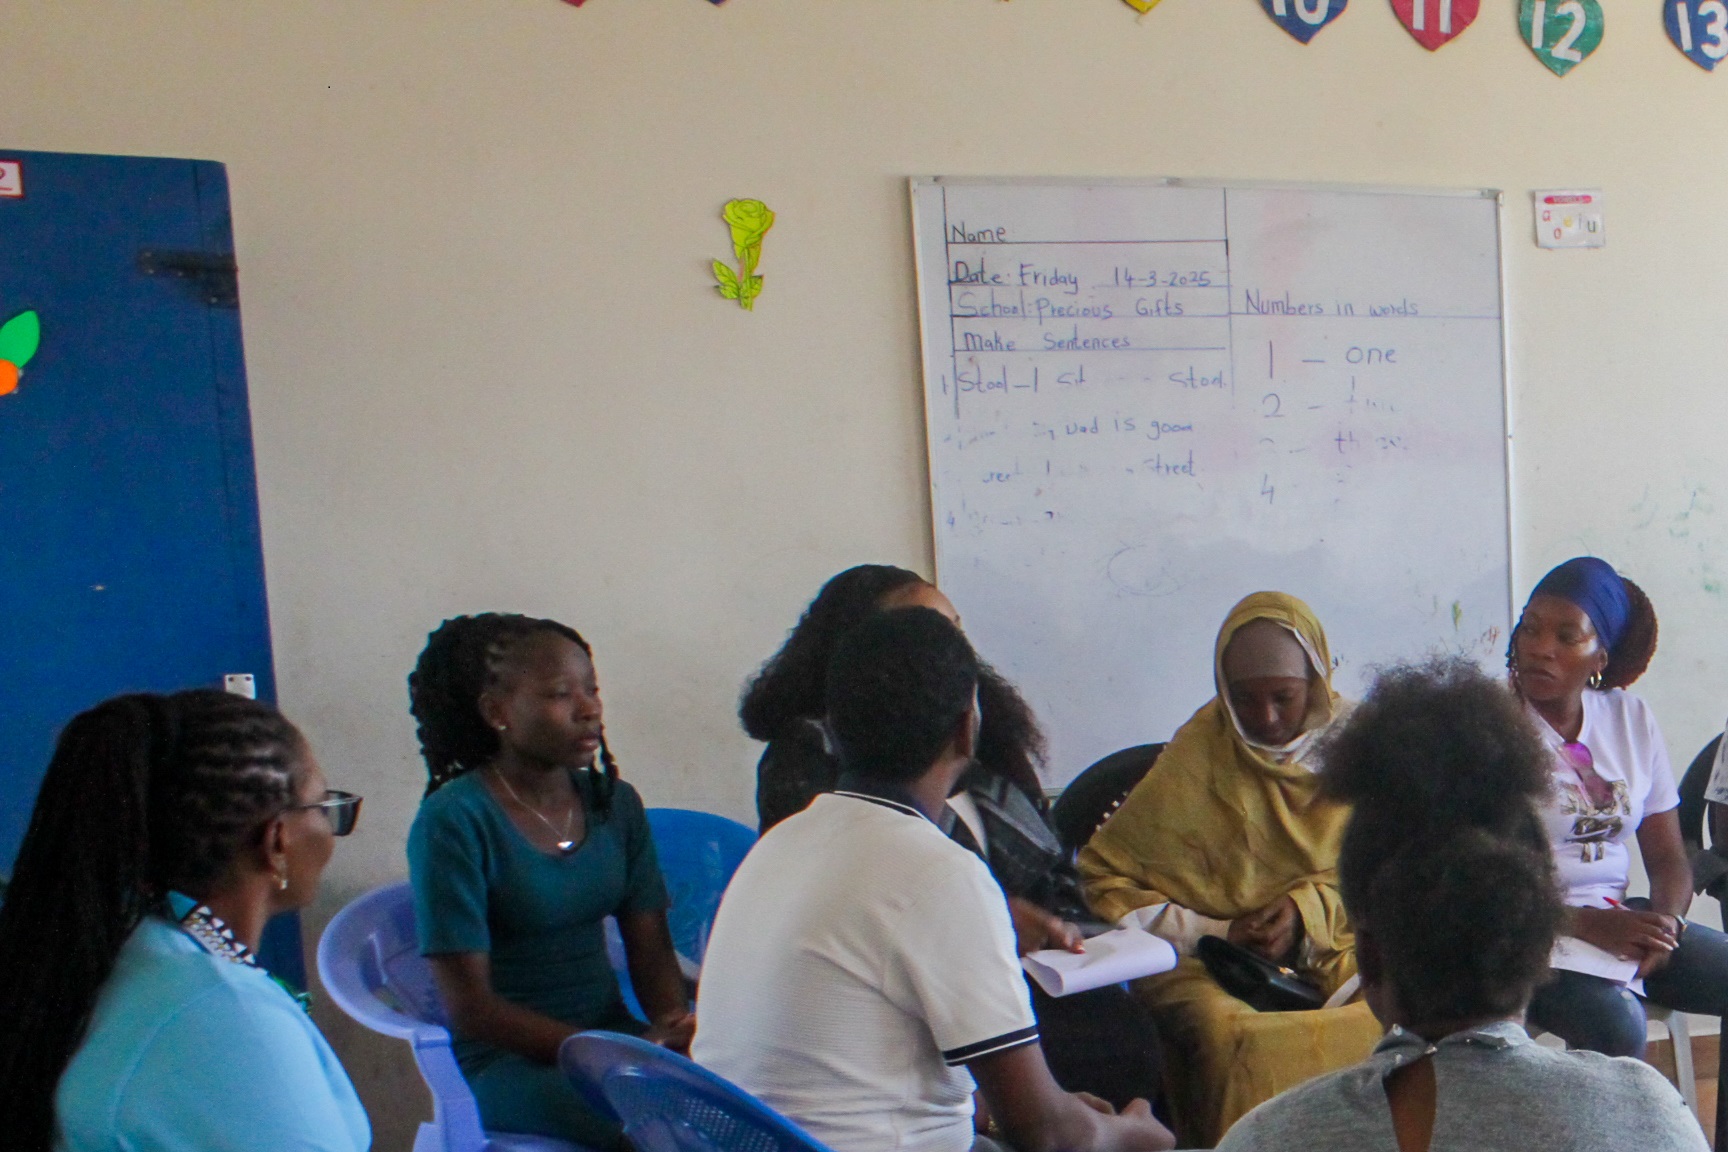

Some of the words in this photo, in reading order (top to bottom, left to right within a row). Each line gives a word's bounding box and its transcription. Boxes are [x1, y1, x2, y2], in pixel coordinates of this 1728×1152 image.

[1531, 0, 1588, 62] 12
[951, 221, 1007, 243] Name
[1019, 263, 1079, 294] Friday
[1113, 267, 1212, 287] 14-3-2025
[1135, 291, 1184, 316] Gifts
[1245, 288, 1324, 315] Numbers
[1336, 302, 1355, 316] in
[1369, 298, 1419, 317] words
[1043, 324, 1132, 348] Sentences
[1262, 392, 1286, 418] 2
[1260, 473, 1275, 505] 4
